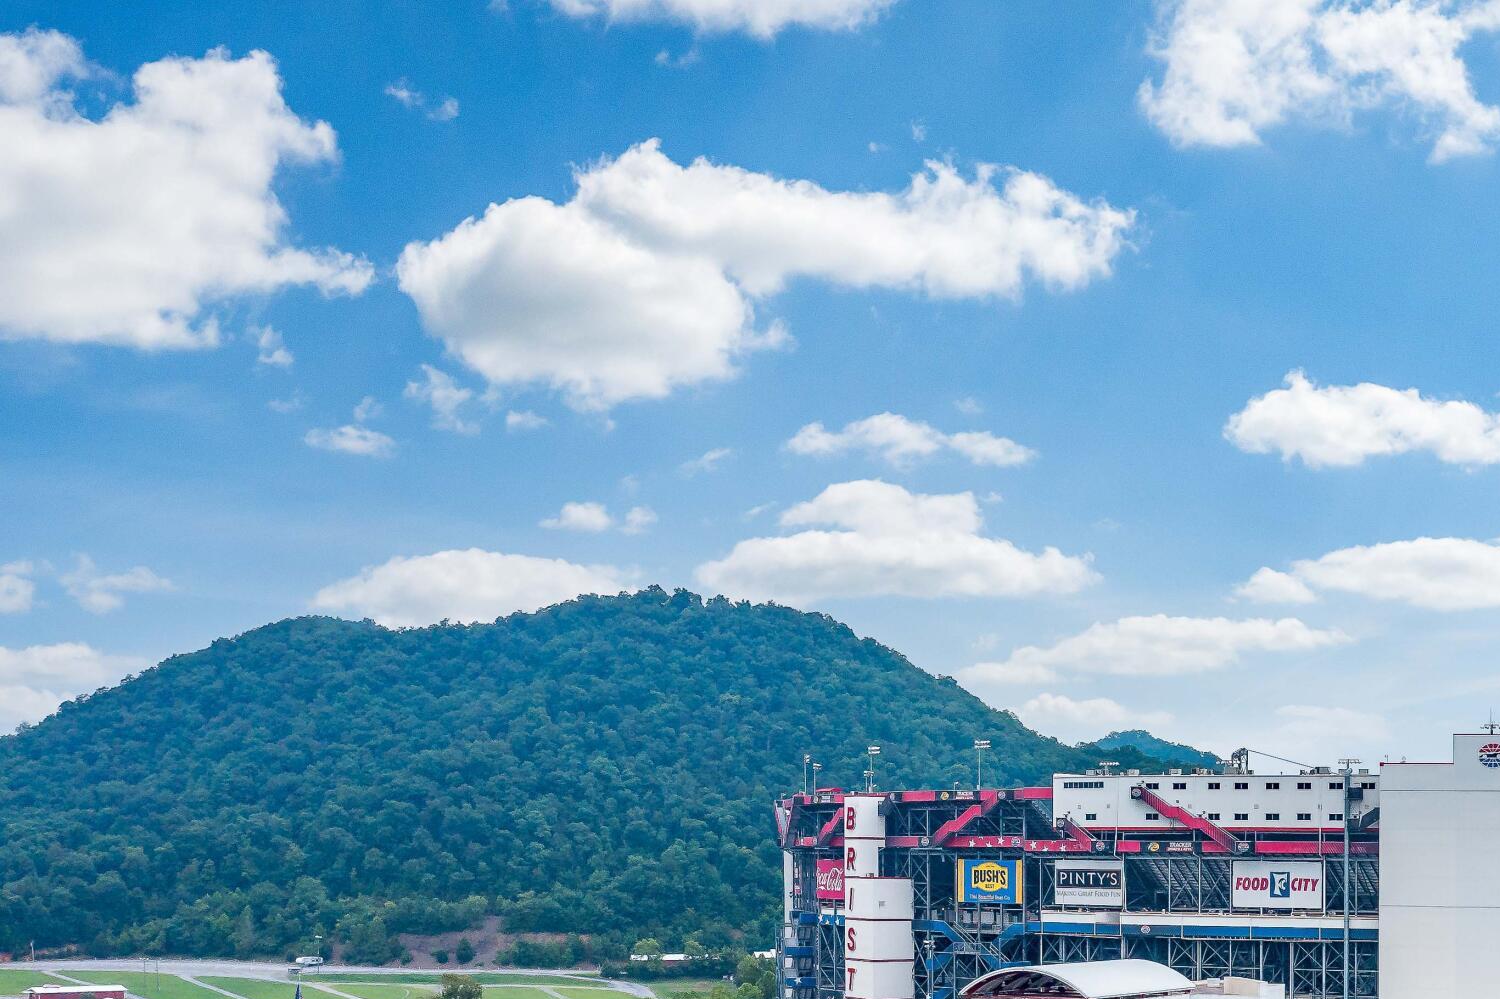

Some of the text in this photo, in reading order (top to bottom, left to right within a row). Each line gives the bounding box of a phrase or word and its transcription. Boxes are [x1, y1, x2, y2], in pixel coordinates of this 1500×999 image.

[973, 869, 1006, 886] BUSH'S
[1235, 877, 1320, 892] FOOD CITY
